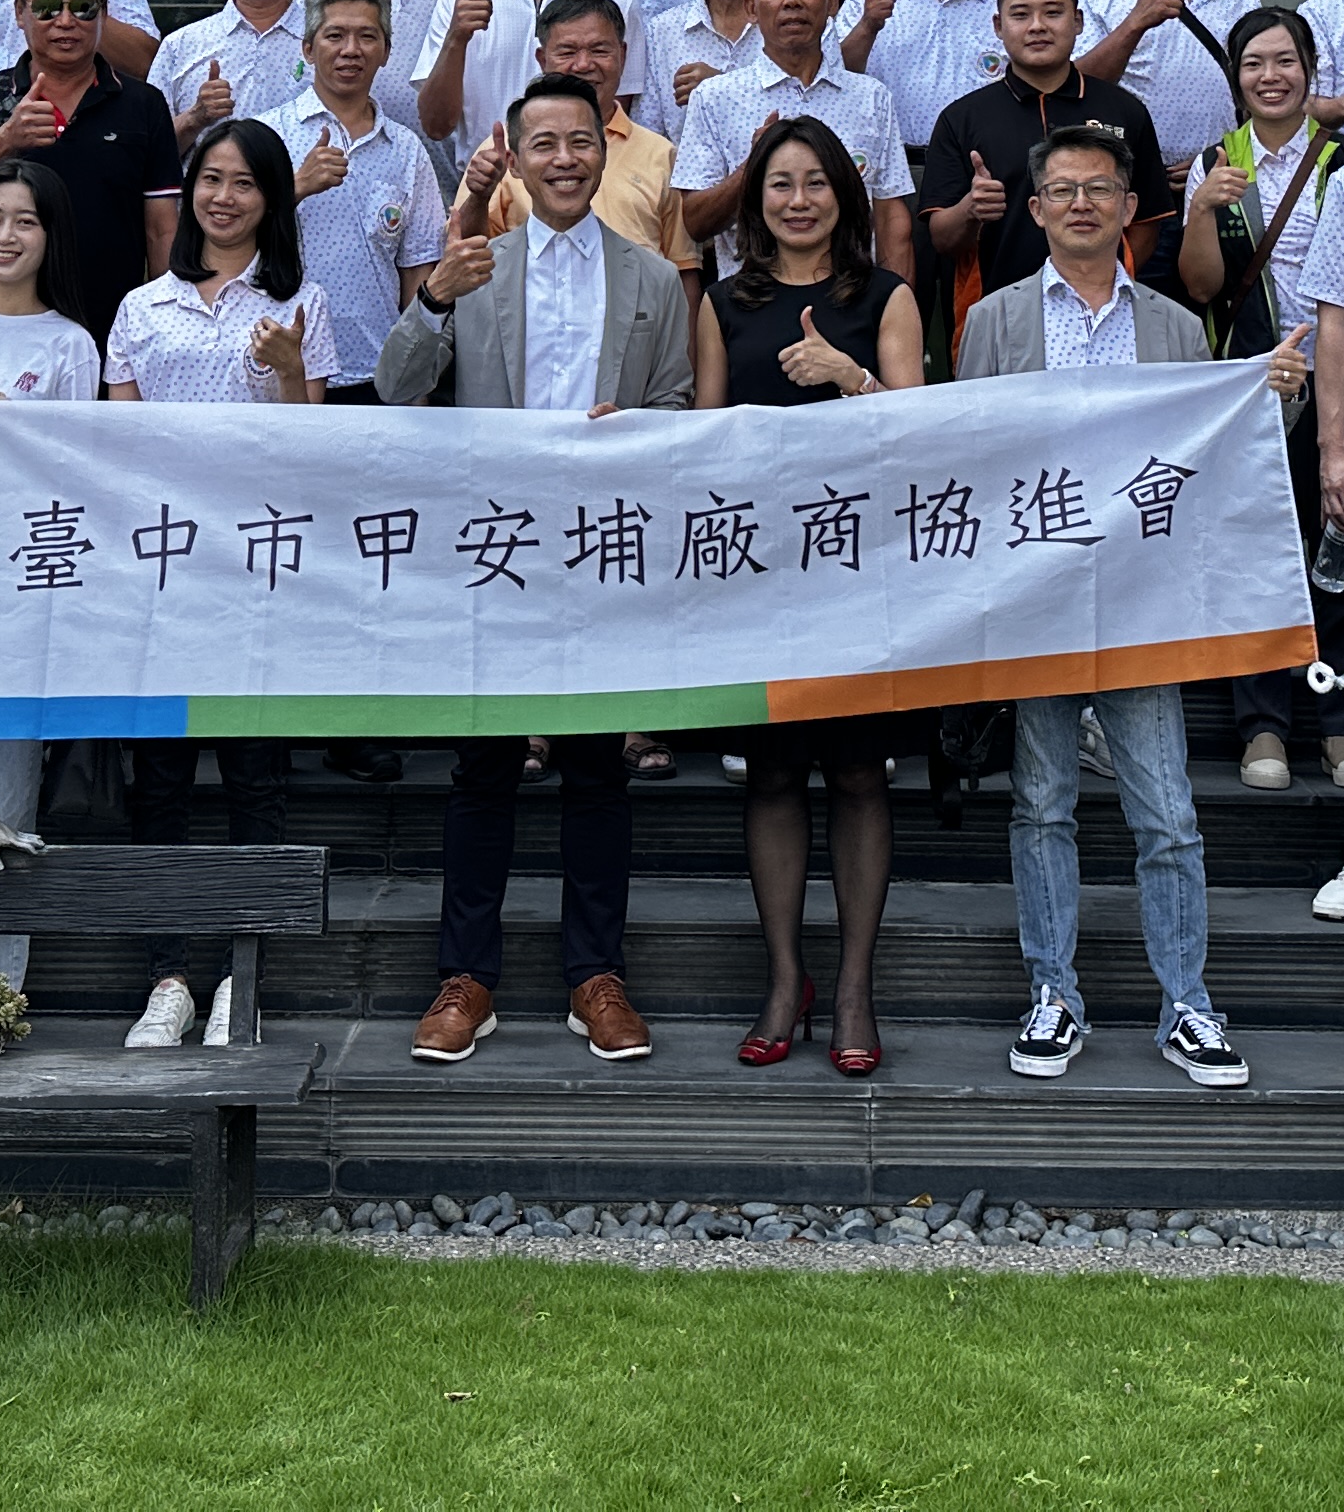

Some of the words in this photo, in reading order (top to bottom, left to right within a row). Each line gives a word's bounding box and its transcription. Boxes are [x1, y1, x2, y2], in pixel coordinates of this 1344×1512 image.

[9, 455, 1199, 591] 臺中市甲安埔廠商協進會
